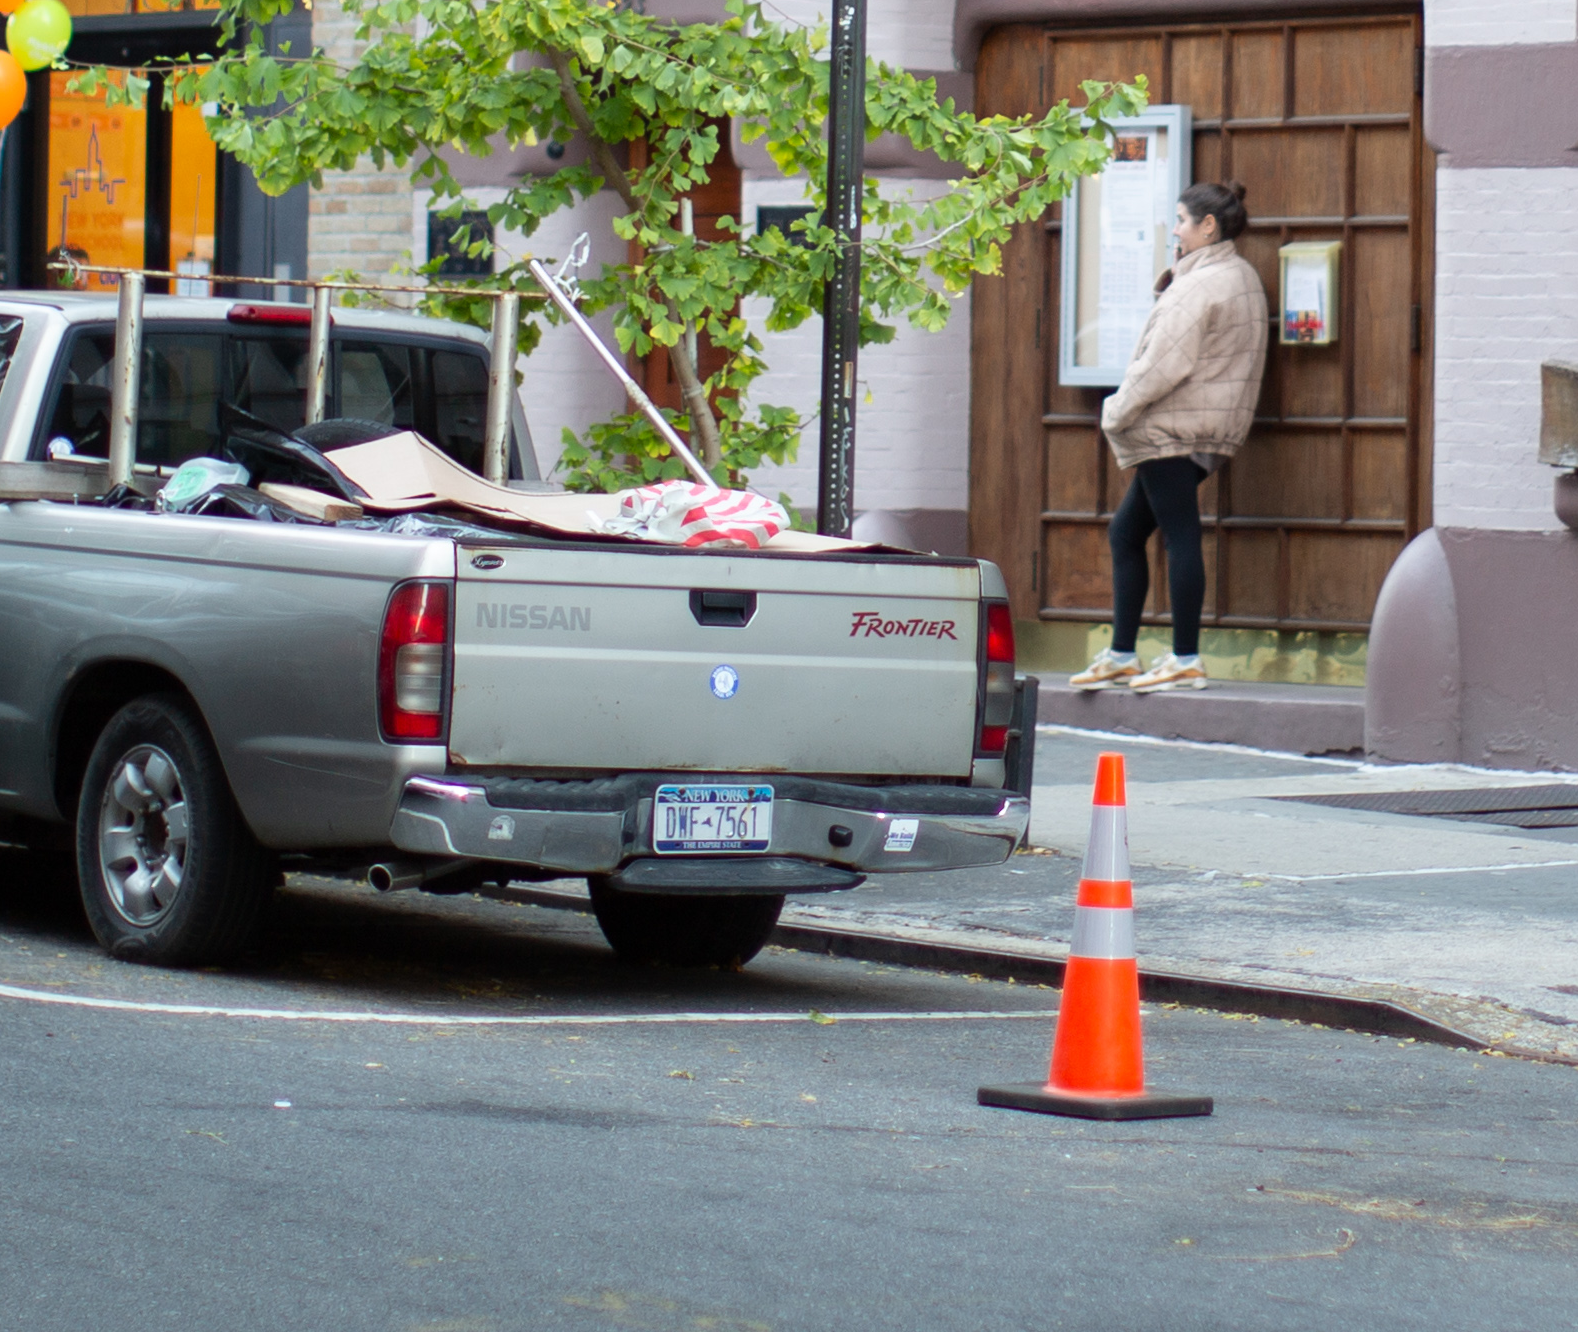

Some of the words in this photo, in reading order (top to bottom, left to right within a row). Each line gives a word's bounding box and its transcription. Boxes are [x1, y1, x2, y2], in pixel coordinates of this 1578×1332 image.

[476, 602, 591, 631] NISSAN
[685, 788, 711, 802] NEW
[716, 788, 745, 802] YORK
